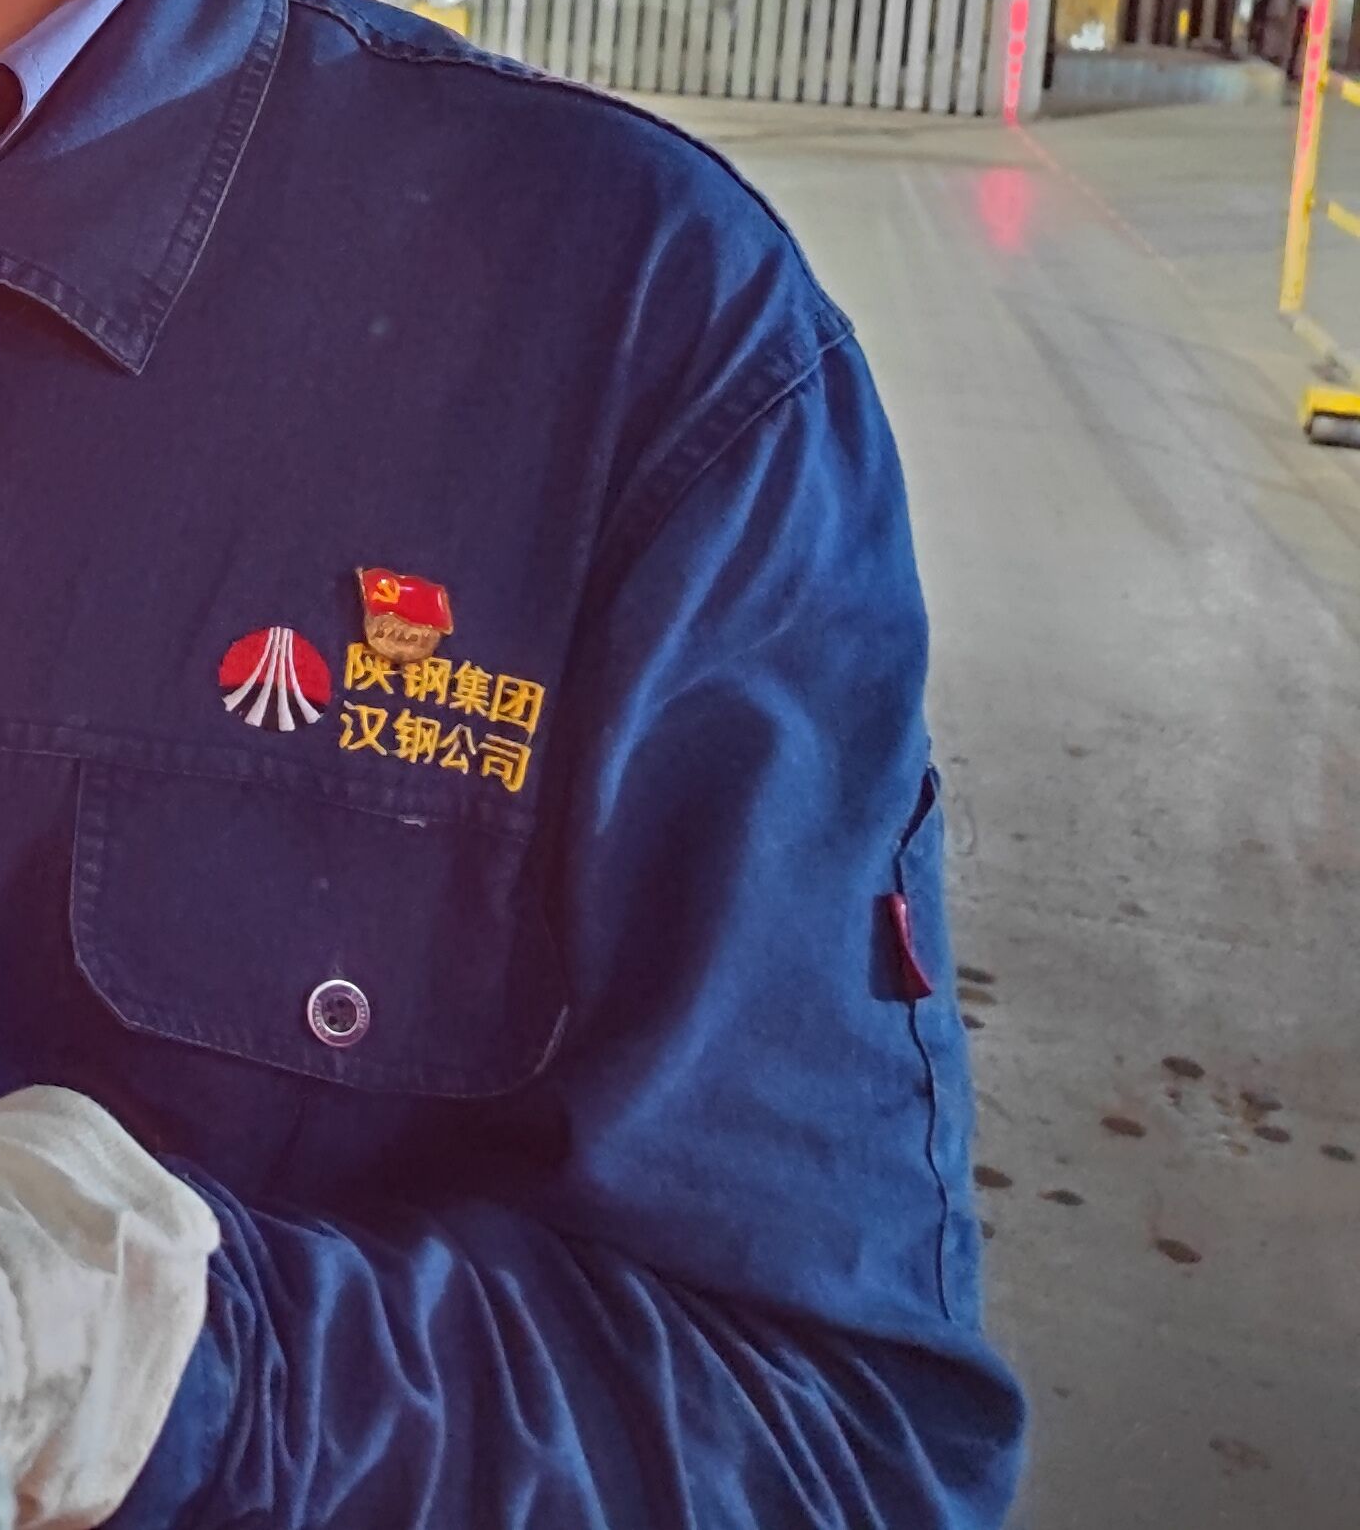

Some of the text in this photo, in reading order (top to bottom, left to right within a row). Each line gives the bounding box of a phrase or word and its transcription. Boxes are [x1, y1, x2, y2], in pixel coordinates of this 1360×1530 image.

[344, 642, 546, 735] 陕钢集团
[340, 700, 532, 792] 汉钢公司
